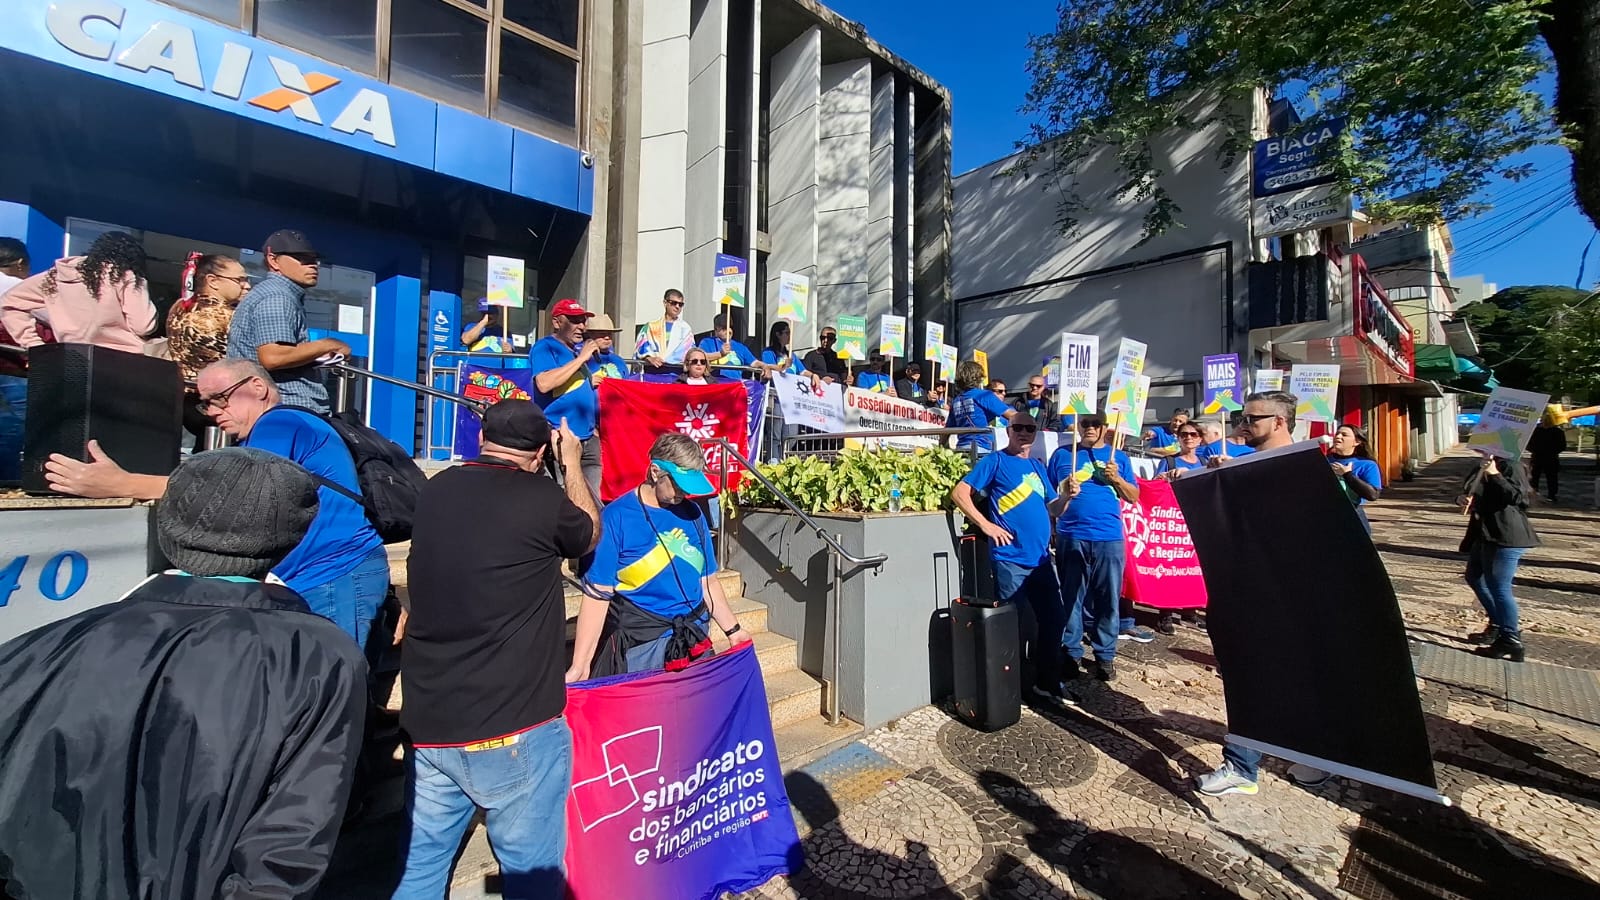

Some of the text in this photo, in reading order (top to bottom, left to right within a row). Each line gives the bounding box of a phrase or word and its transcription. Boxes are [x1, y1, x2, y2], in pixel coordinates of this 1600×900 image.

[46, 4, 397, 147] CAIXA
[1292, 208, 1338, 222] Seguros
[1068, 344, 1091, 369] FIM
[1207, 362, 1236, 380] MAIS
[849, 392, 855, 407] O
[857, 396, 891, 415] assédio
[893, 403, 917, 420] moral
[859, 416, 891, 431] Queremos
[1149, 519, 1166, 531] dos
[1150, 531, 1161, 543] de
[1149, 548, 1155, 558] e
[642, 739, 764, 813] sindicato
[628, 767, 765, 844] dos bancários
[634, 791, 767, 866] e financiários
[677, 834, 713, 859] Curitiba
[713, 830, 720, 840] e
[721, 817, 751, 836] região
